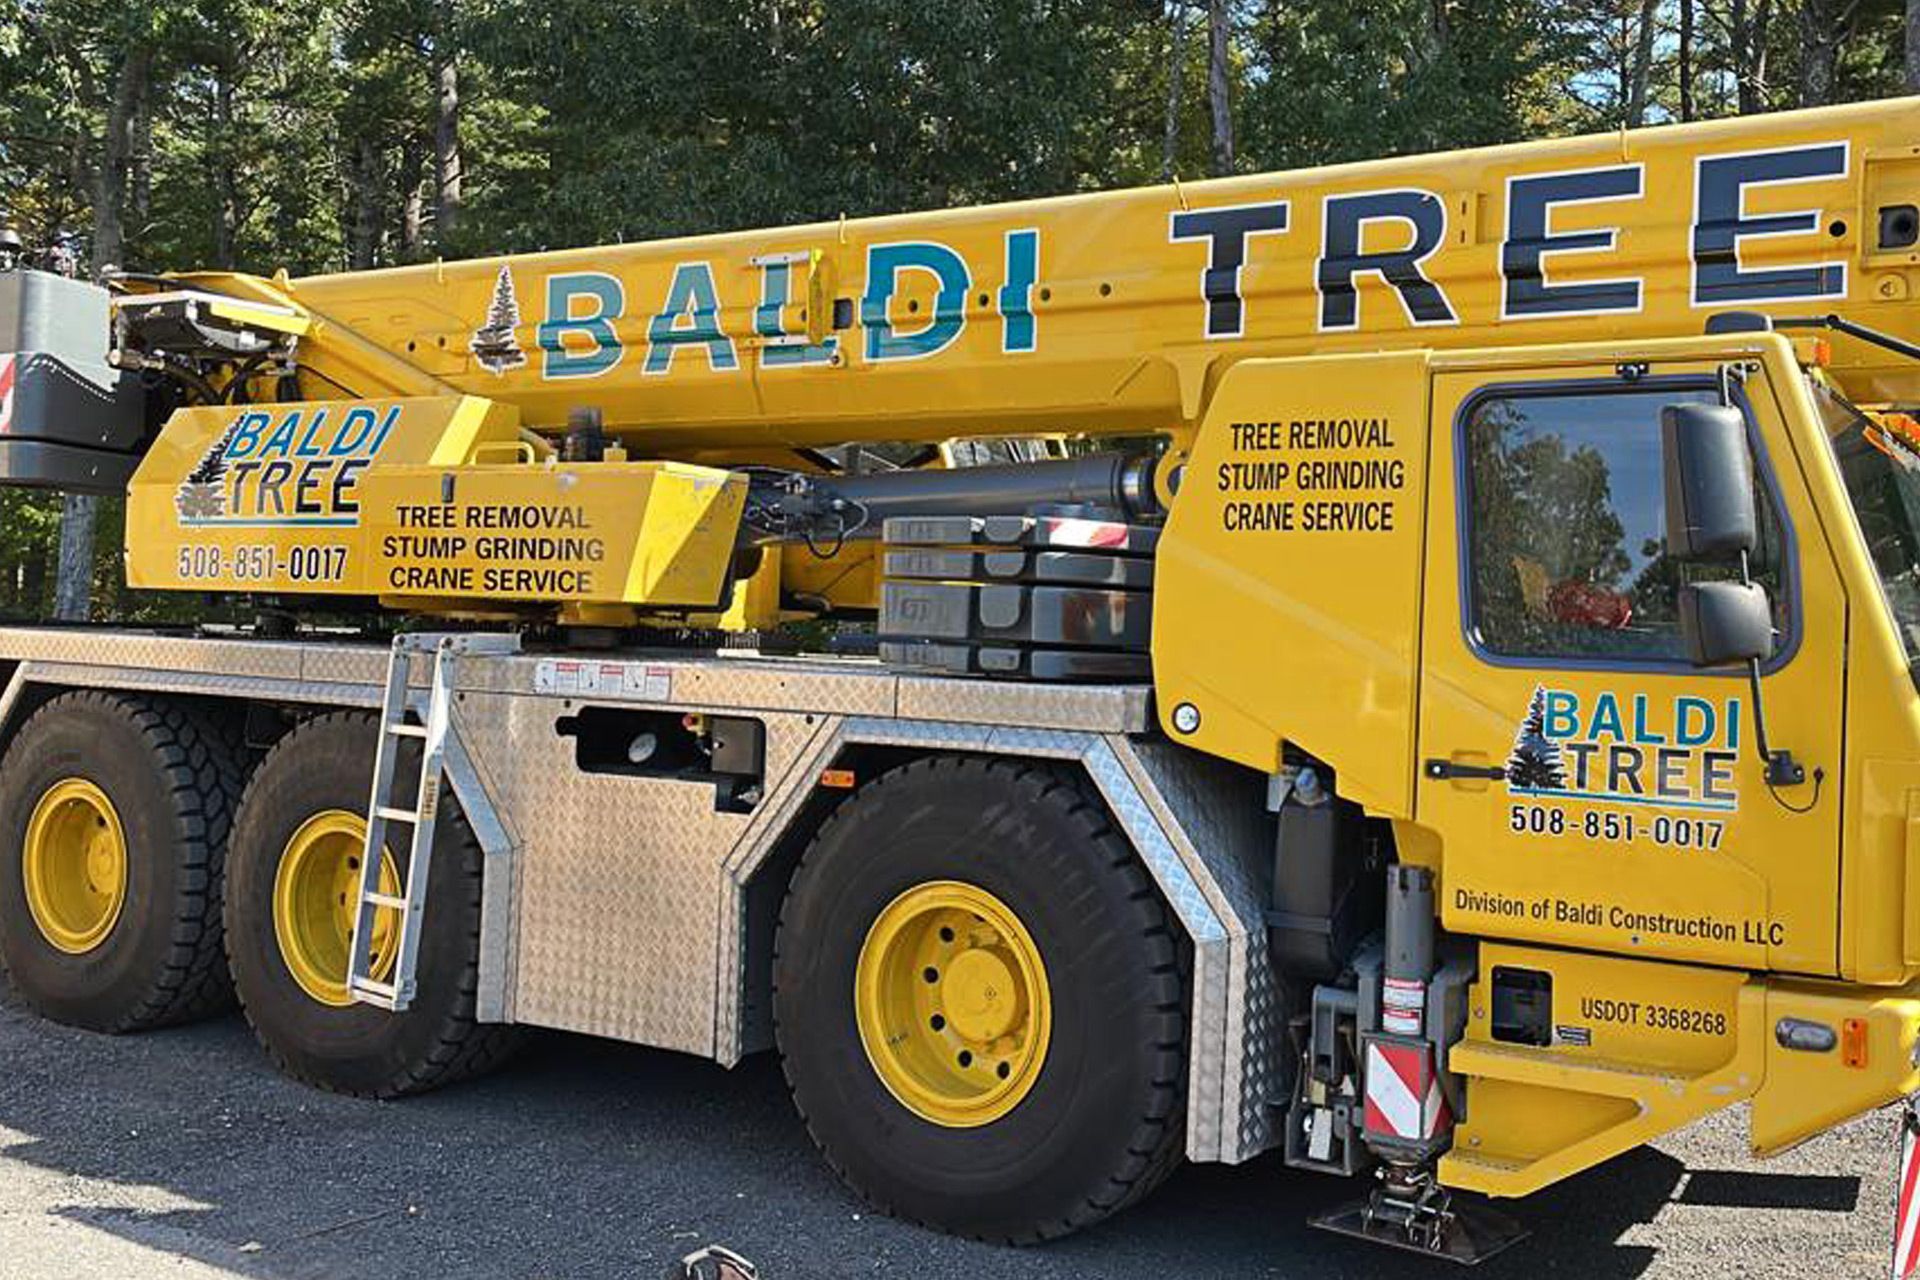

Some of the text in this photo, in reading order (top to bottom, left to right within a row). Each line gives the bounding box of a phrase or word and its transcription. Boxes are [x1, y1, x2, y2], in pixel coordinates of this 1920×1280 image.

[536, 140, 1850, 380] BALDI TREE
[225, 406, 401, 459] BALDI
[1230, 418, 1395, 451] TREE REMOVAL
[231, 459, 371, 515] TREE
[1217, 459, 1404, 491] STUMP GRINDING
[397, 506, 592, 529] TREE REMOVAL
[1223, 501, 1394, 531] CRANE SERVICE
[179, 545, 347, 580] 508-851-0017
[383, 535, 605, 562] STUMP GRINDING
[389, 567, 594, 593] CRANE SERVICE
[1543, 690, 1741, 749] BALDI
[1566, 743, 1738, 801] TREE
[1510, 806, 1724, 849] 508-851-0017
[1455, 889, 1785, 946] Division of Baldi Construction LLC
[1581, 997, 1726, 1036] USDOT 3368268
